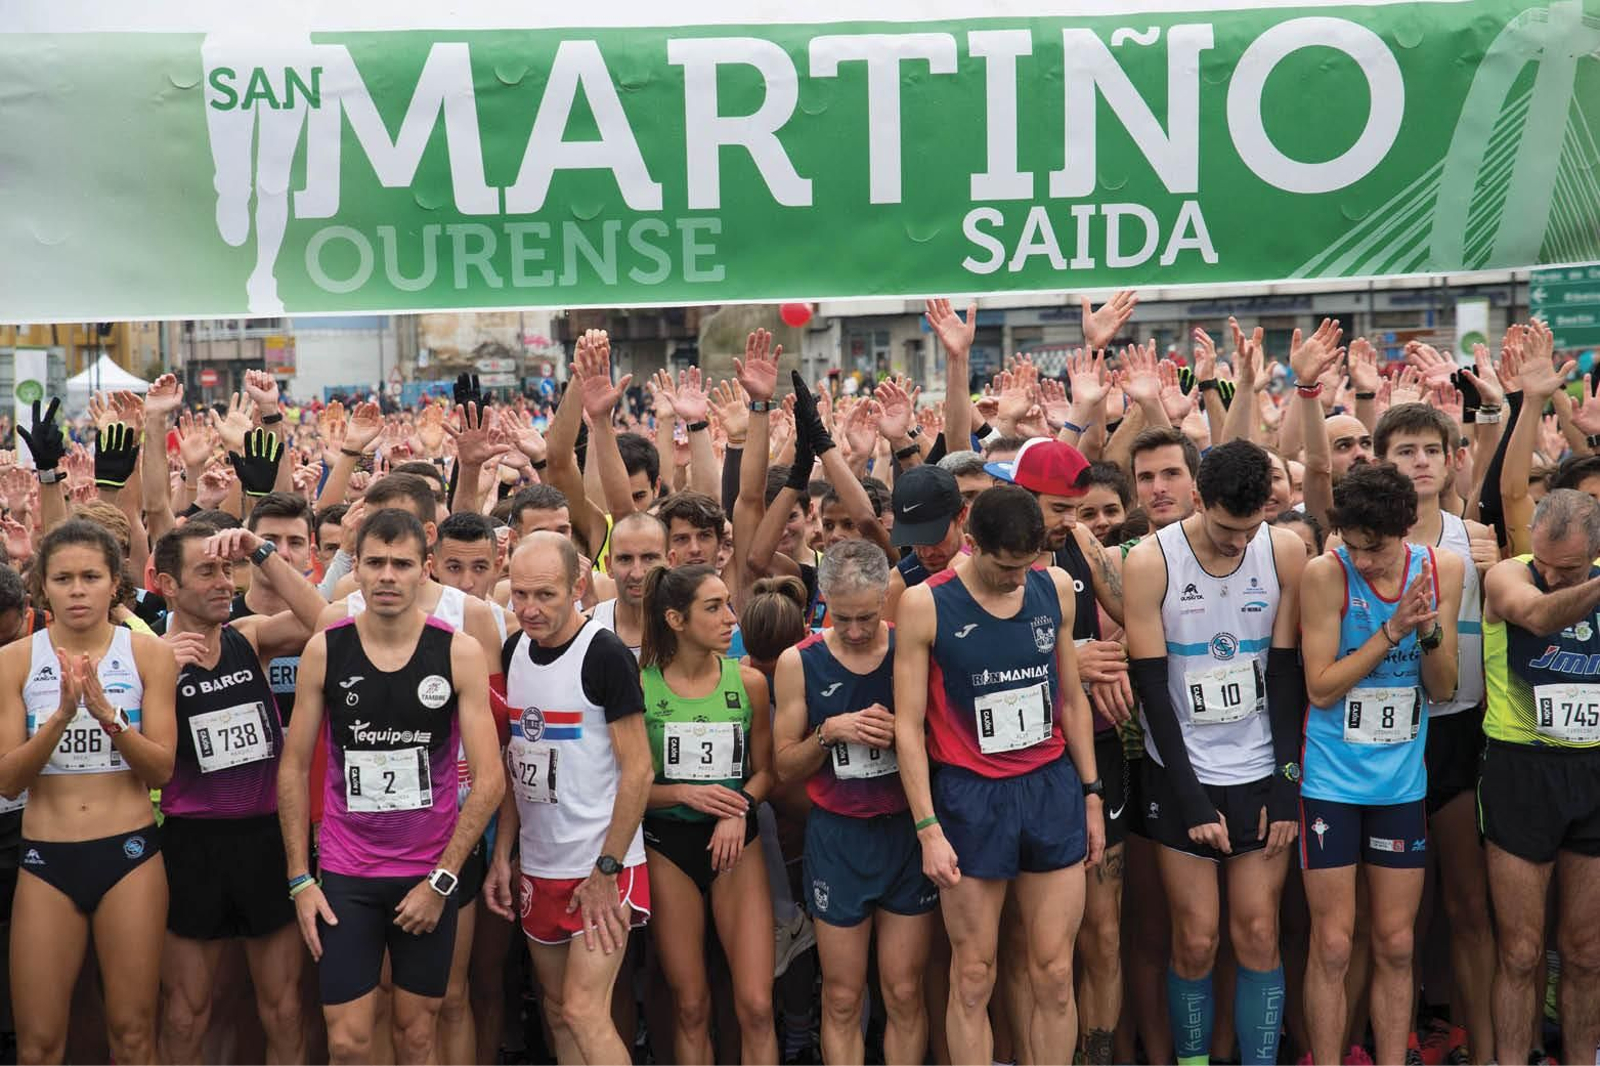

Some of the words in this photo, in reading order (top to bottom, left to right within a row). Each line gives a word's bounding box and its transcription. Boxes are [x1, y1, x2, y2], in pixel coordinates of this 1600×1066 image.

[208, 66, 323, 111] SAN
[294, 17, 1405, 219] MARTIÑO
[962, 201, 1219, 275] SAIDA
[304, 218, 726, 293] OURENSE
[182, 685, 196, 697] O
[200, 669, 253, 694] BARCO
[1221, 683, 1241, 708] 10
[1018, 708, 1025, 732] 1
[1382, 706, 1394, 728] 8
[1561, 703, 1600, 727] 745
[59, 729, 102, 753] 386
[218, 722, 259, 752] 738
[701, 742, 713, 764] 3
[383, 771, 396, 794] 2
[519, 761, 537, 787] 22
